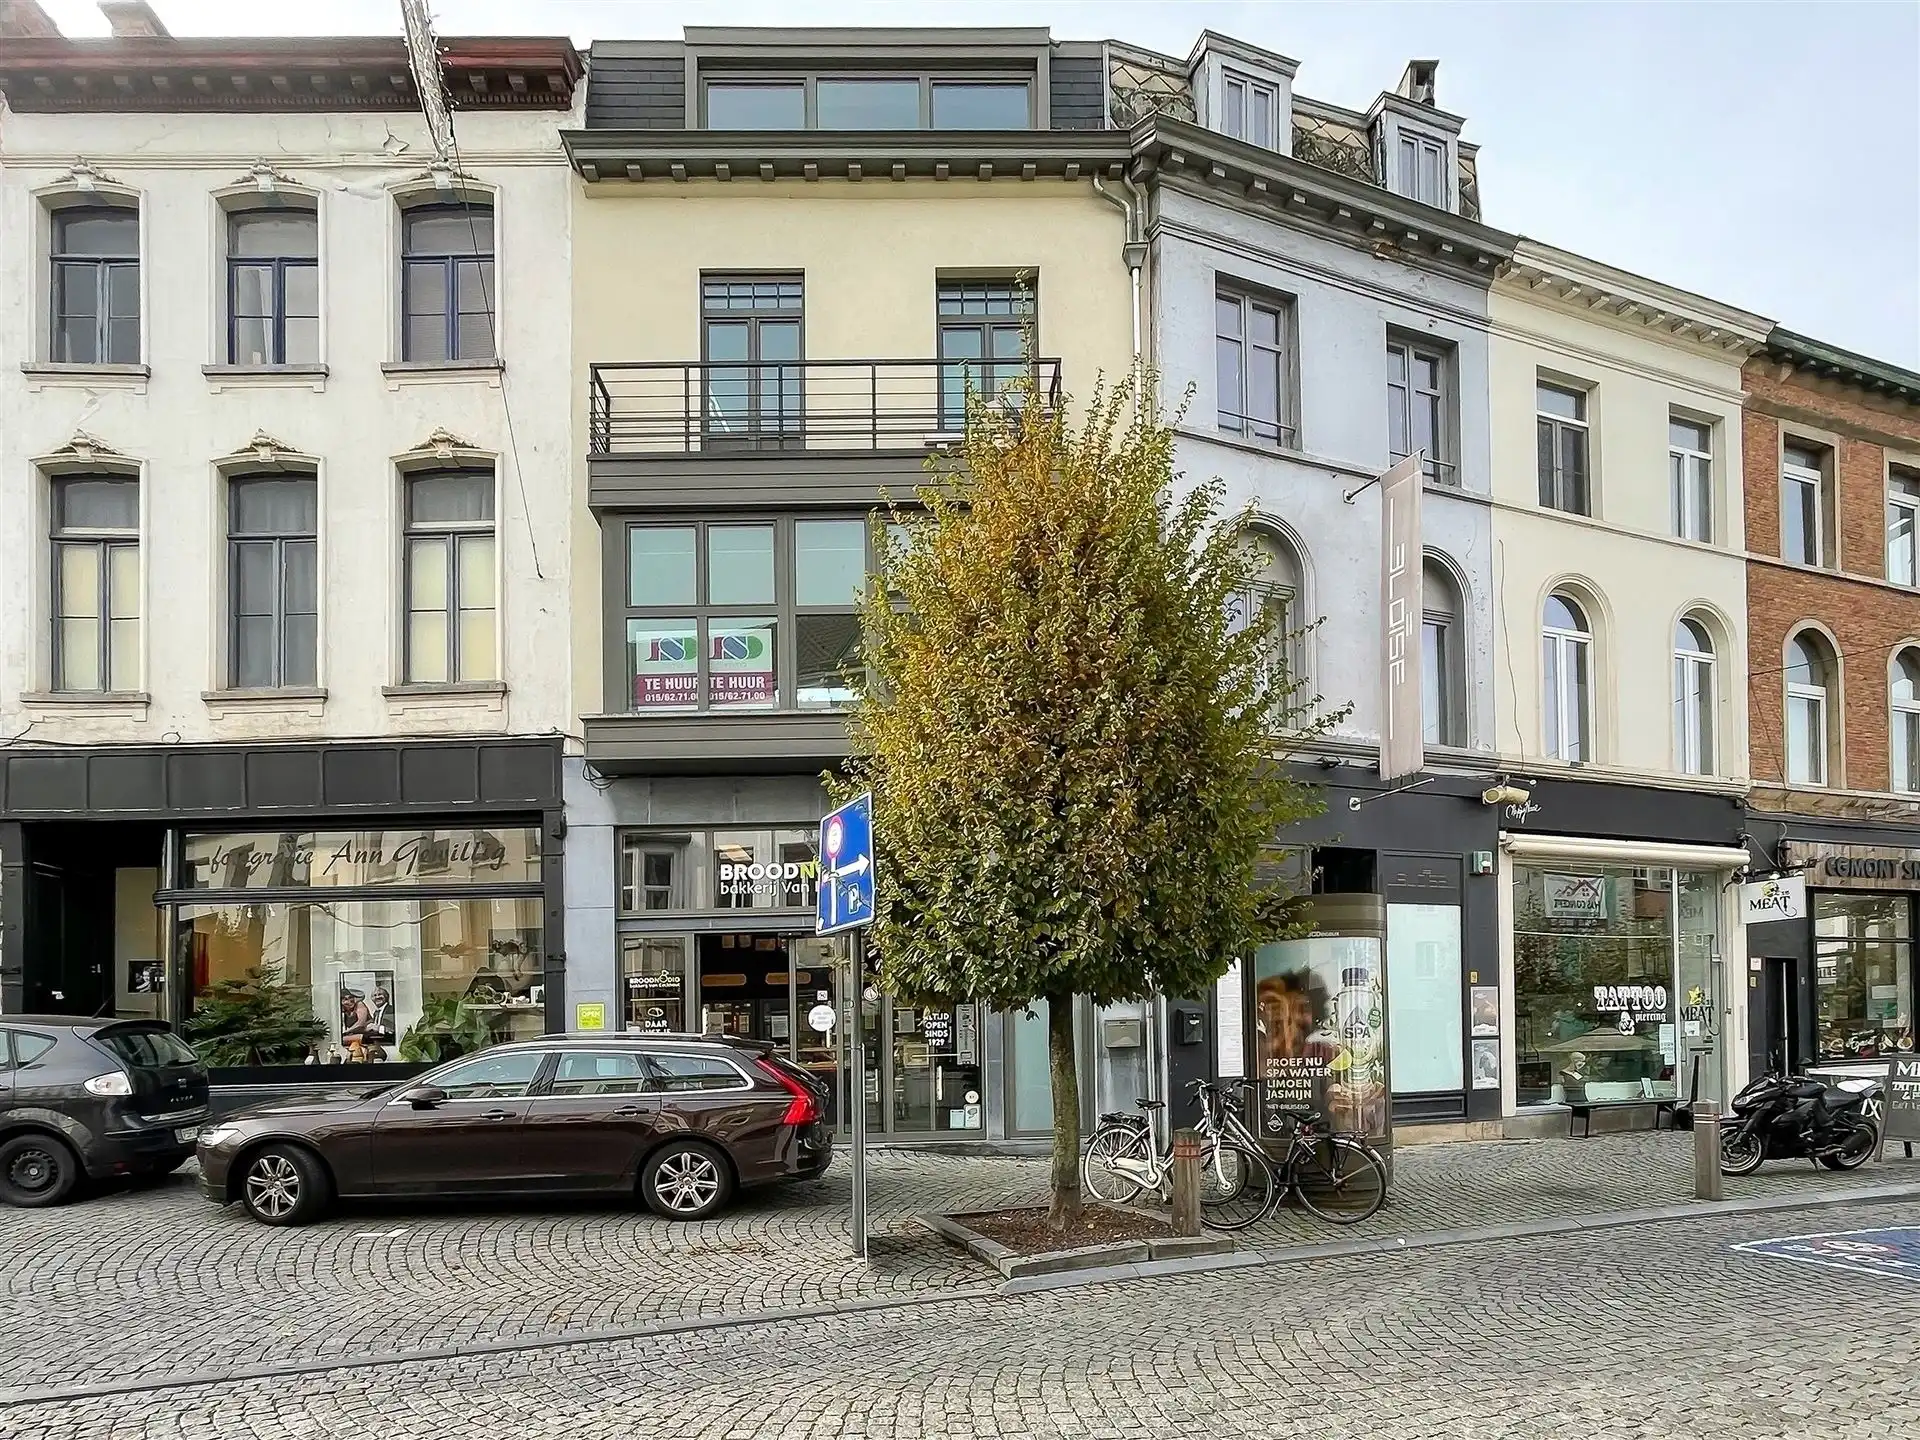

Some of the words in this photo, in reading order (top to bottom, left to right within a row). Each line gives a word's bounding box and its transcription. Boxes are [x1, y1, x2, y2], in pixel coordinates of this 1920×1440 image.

[644, 678, 660, 690] TE
[709, 676, 724, 688] TE
[729, 676, 765, 688] HUUR
[323, 839, 383, 875] Ann
[720, 863, 819, 880] BROODN
[1825, 857, 1900, 879] EGMONT
[720, 881, 777, 897] bakkerij
[781, 881, 809, 893] Van
[1749, 896, 1798, 918] MEAT
[1594, 985, 1667, 1011] TATTOO
[1635, 1011, 1666, 1023] piercing
[1680, 1006, 1720, 1036] MEAT
[645, 1020, 668, 1028] DAAR
[925, 1021, 947, 1029] OPEN
[925, 1030, 948, 1038] SINDS
[1344, 1026, 1371, 1039] SPA
[928, 1038, 945, 1046] 1929
[1266, 1058, 1303, 1067] PROEF
[1305, 1057, 1322, 1066] NU
[1266, 1068, 1287, 1078] SPA
[1289, 1067, 1332, 1077] WATER
[1267, 1079, 1312, 1088] LIMOEN
[1265, 1089, 1312, 1101] JASMIJN
